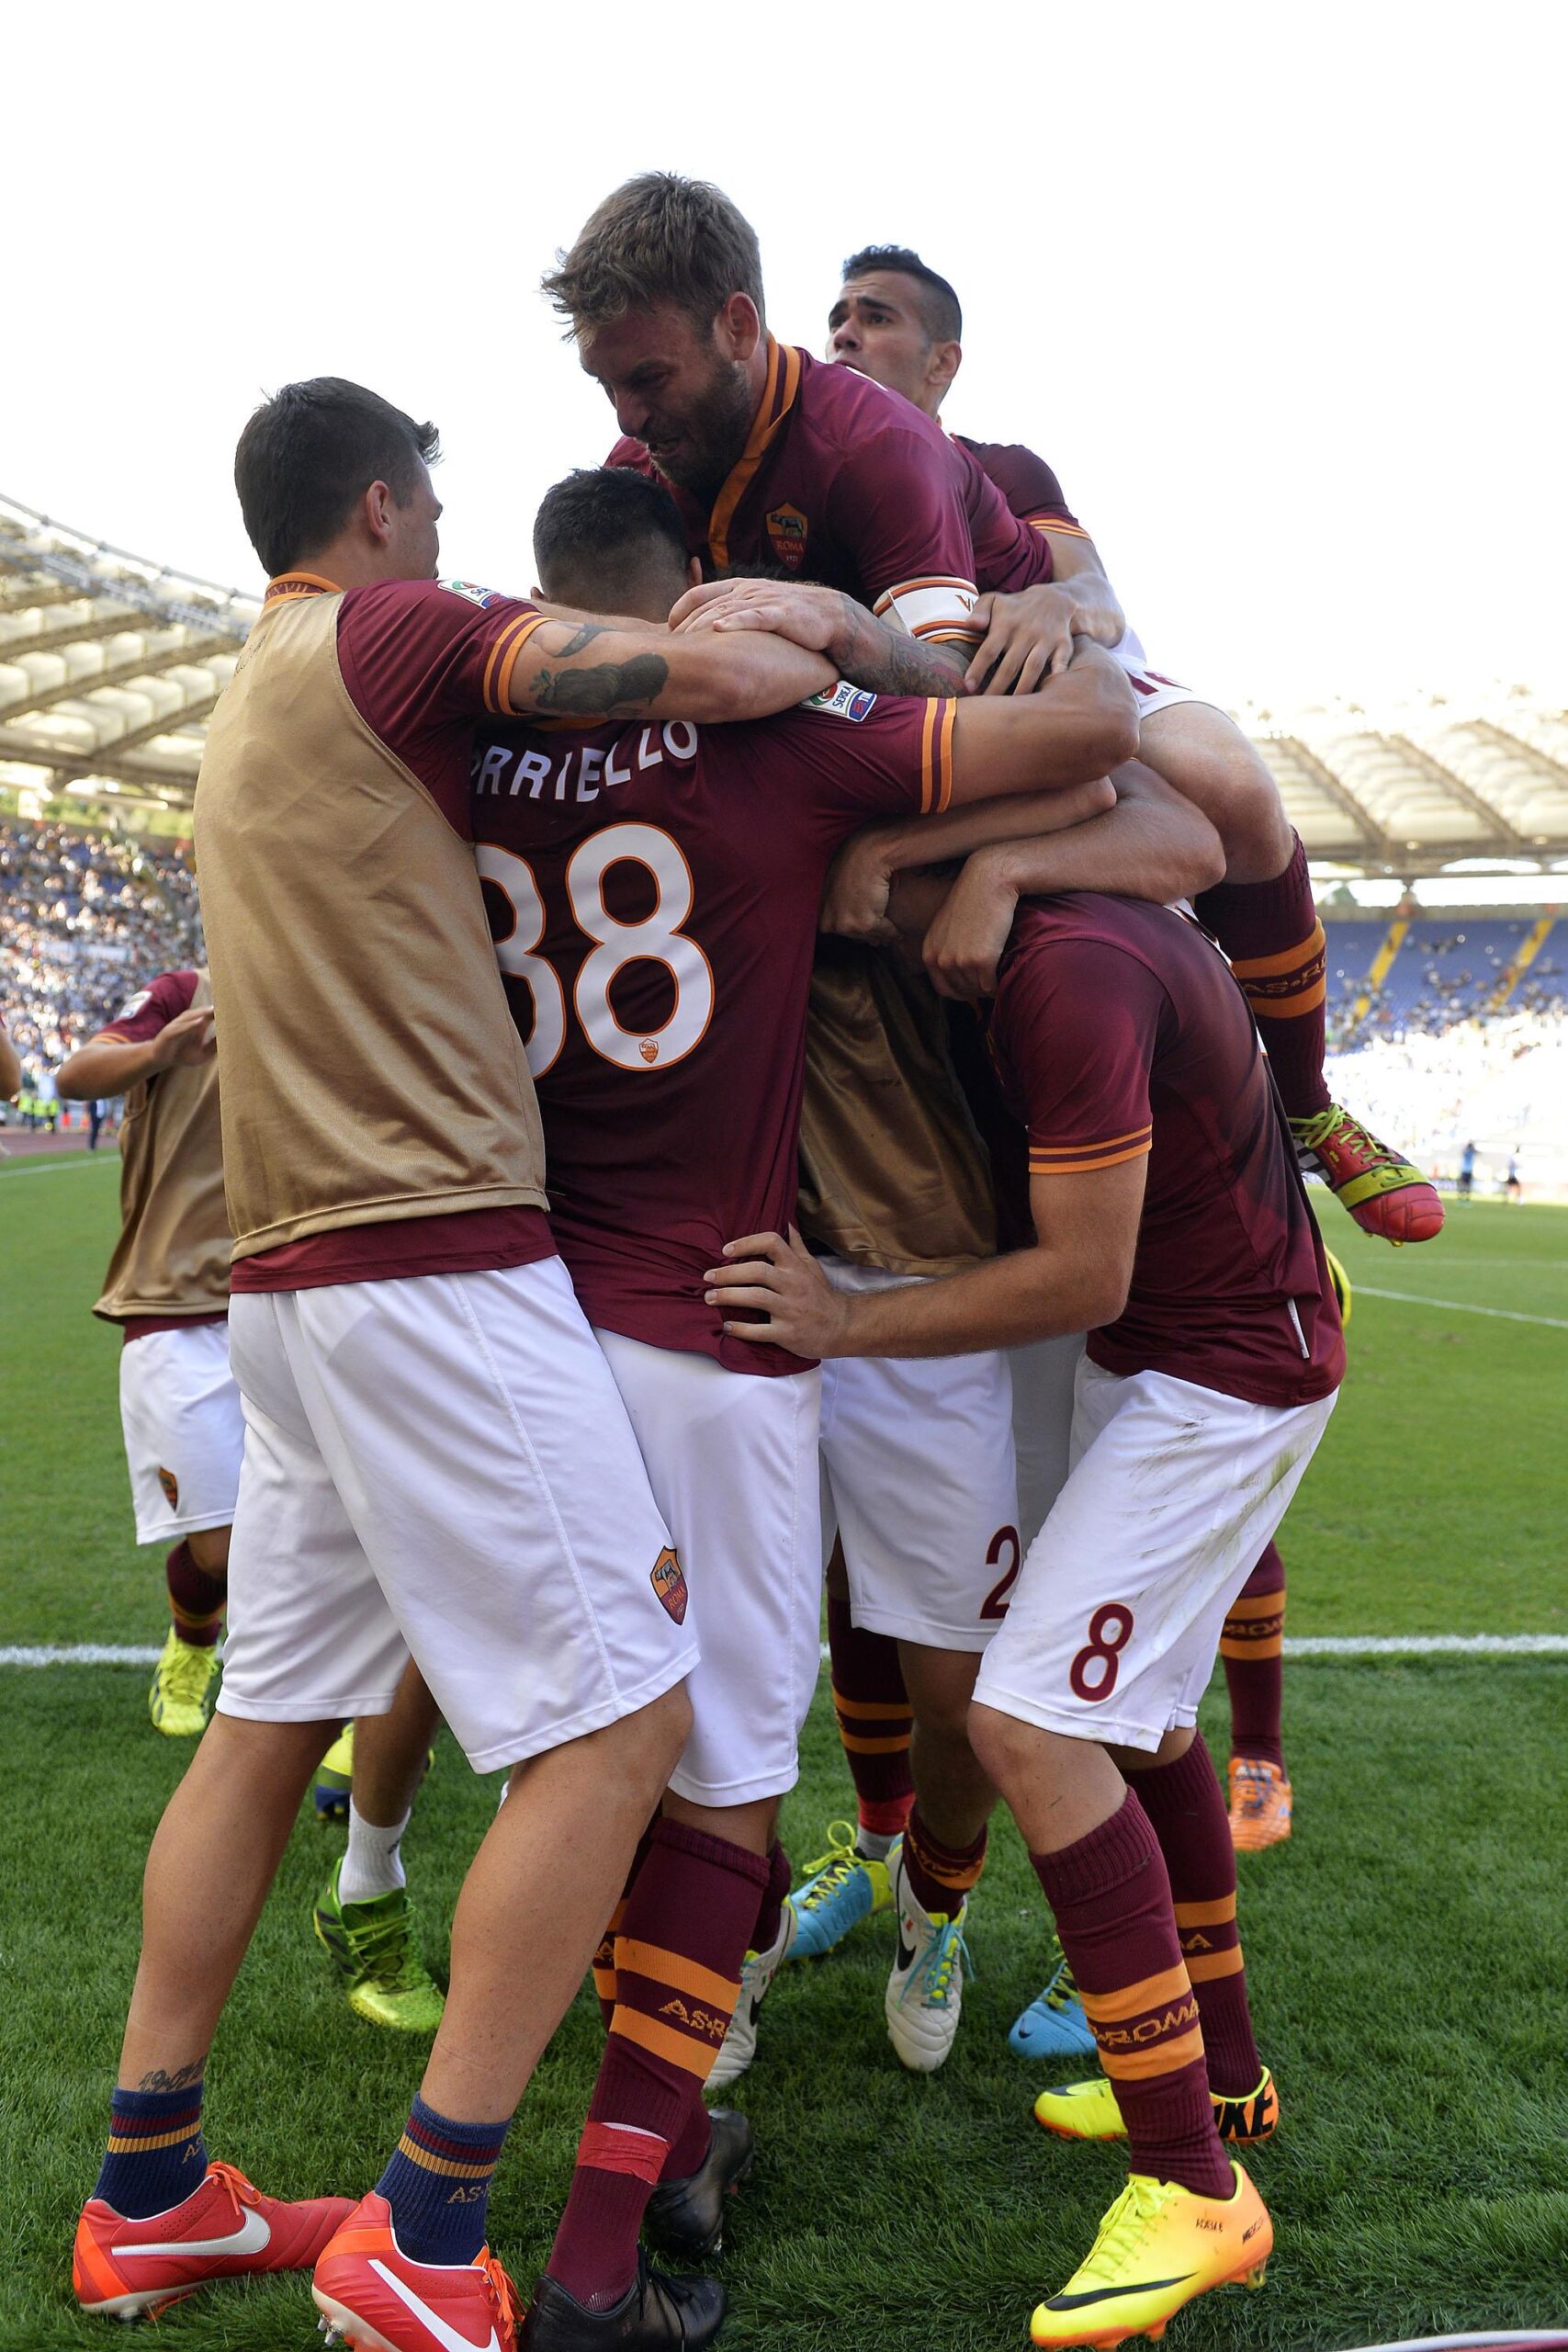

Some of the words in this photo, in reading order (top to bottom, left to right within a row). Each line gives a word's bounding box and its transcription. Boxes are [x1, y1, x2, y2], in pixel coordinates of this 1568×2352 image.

[777, 540, 804, 551] ROMA
[470, 719, 698, 802] RRIELLO
[1069, 1602, 1134, 1703] 8
